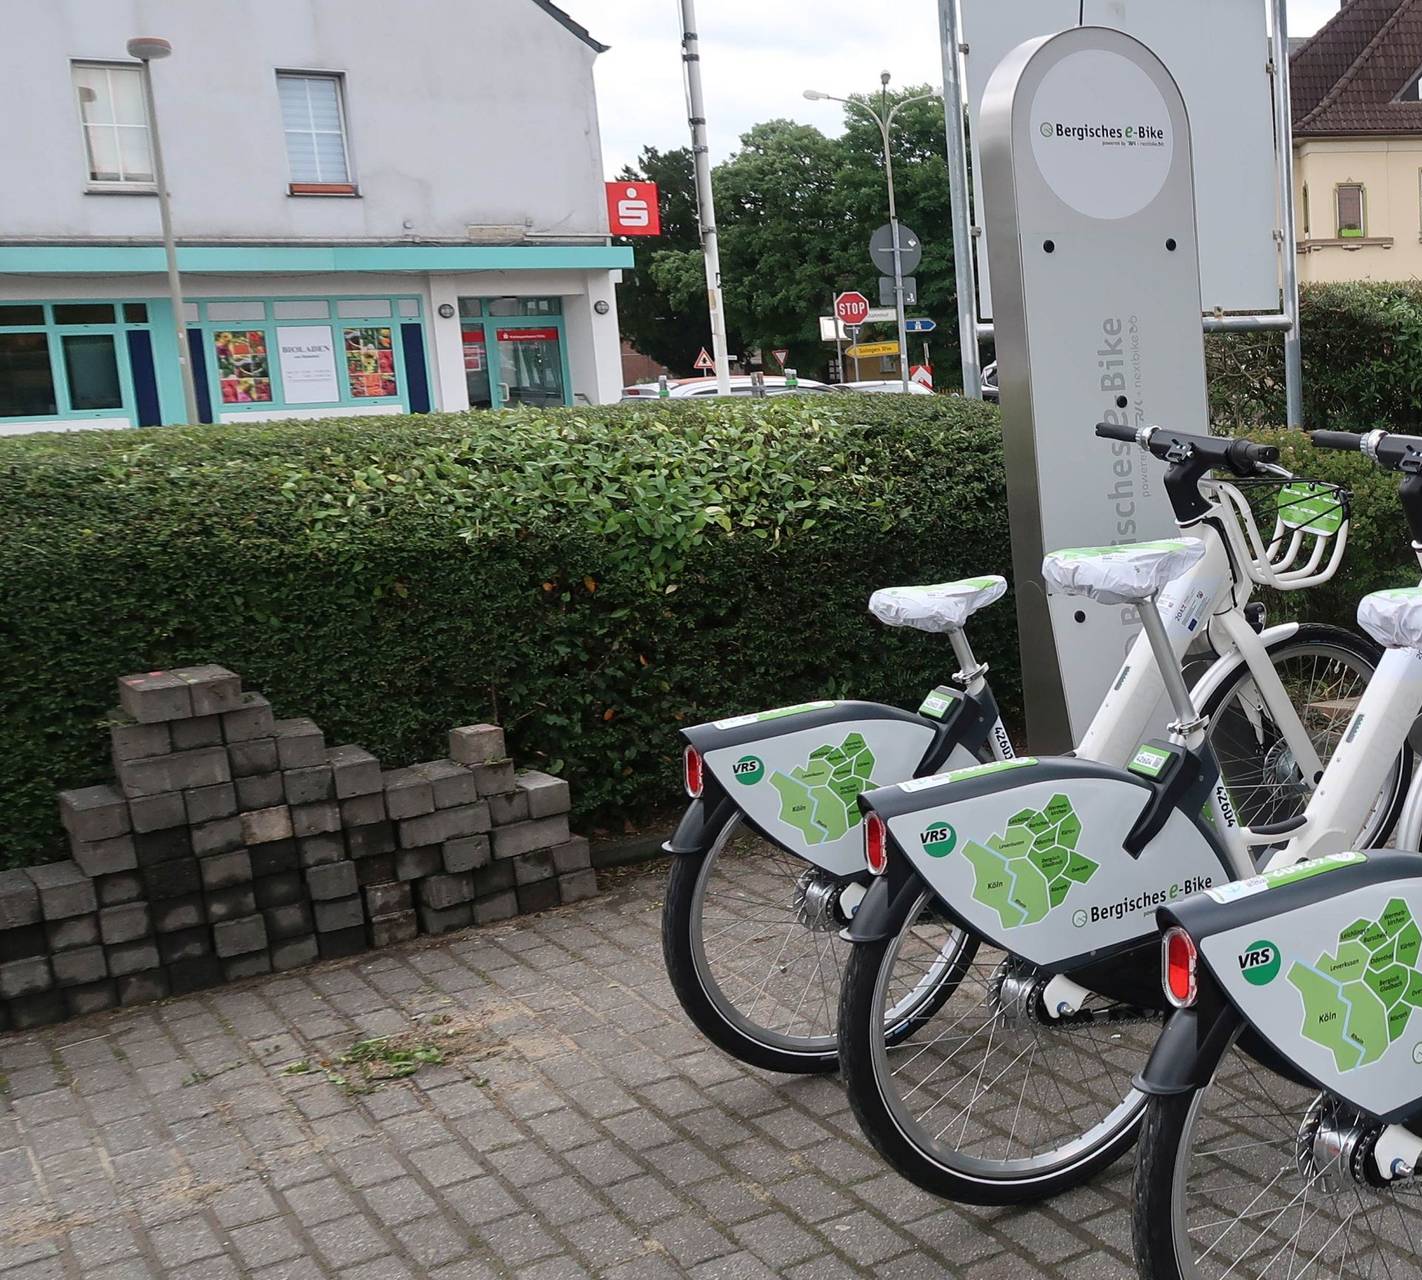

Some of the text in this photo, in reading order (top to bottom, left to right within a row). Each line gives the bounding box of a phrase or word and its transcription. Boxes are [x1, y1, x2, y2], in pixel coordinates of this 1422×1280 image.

[1056, 123, 1164, 141] Bergisches e-Bike
[839, 302, 865, 315] STOP
[733, 761, 756, 774] VRS
[1216, 786, 1236, 828] 42604
[920, 828, 947, 844] VRS
[987, 880, 1004, 890] Köln
[1091, 875, 1213, 923] Bergisches e-Bike
[1238, 948, 1270, 969] VRS
[1318, 1012, 1337, 1024] Köln
